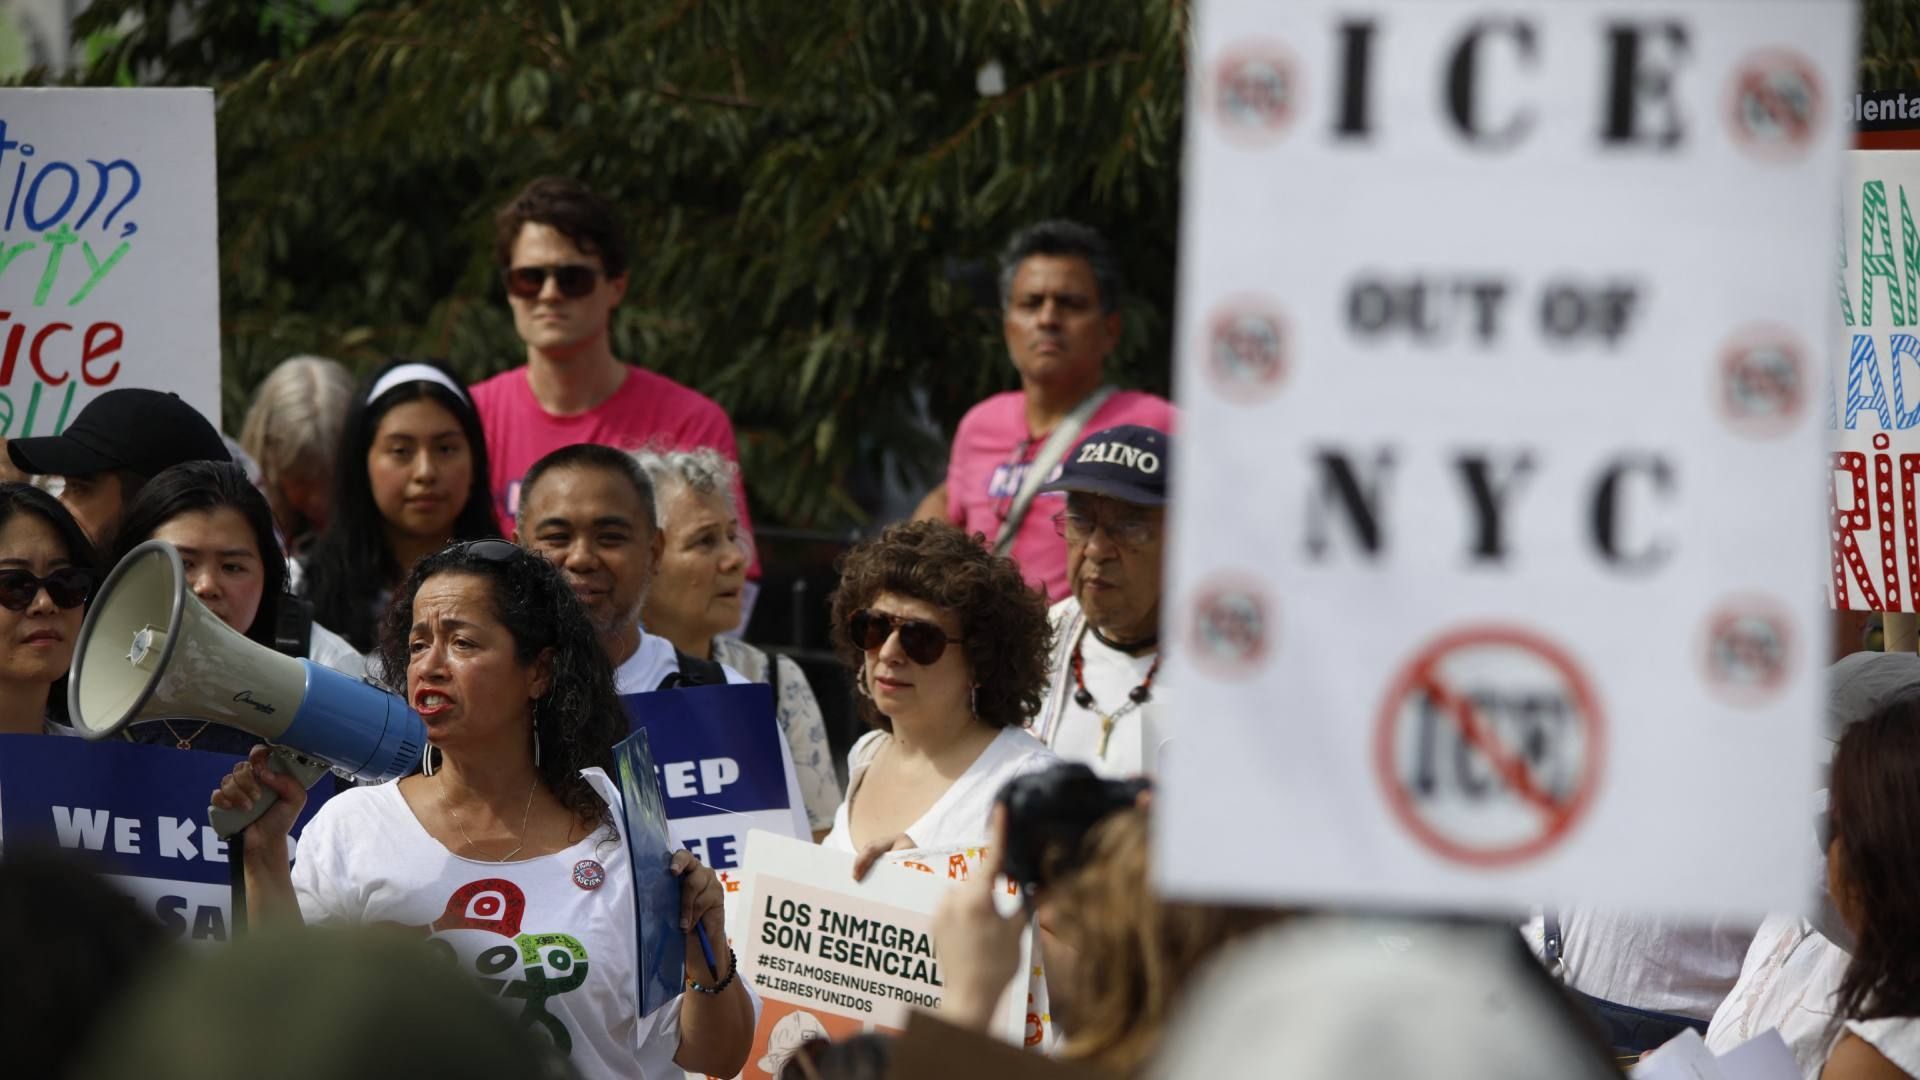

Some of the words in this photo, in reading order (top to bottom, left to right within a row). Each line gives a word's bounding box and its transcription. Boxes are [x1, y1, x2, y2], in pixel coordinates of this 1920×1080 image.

[1330, 15, 1692, 153] ICE
[1344, 278, 1510, 345] OUT
[1537, 281, 1641, 347] OF
[0, 311, 124, 387] ice
[1077, 441, 1160, 474] TAINO
[1305, 446, 1672, 569] NYC
[52, 805, 141, 854] WE
[761, 922, 811, 954] SON
[765, 895, 811, 927] LOS
[818, 908, 938, 960] INMIGRA
[755, 973, 873, 1013] #LIBRESYUNIDOS
